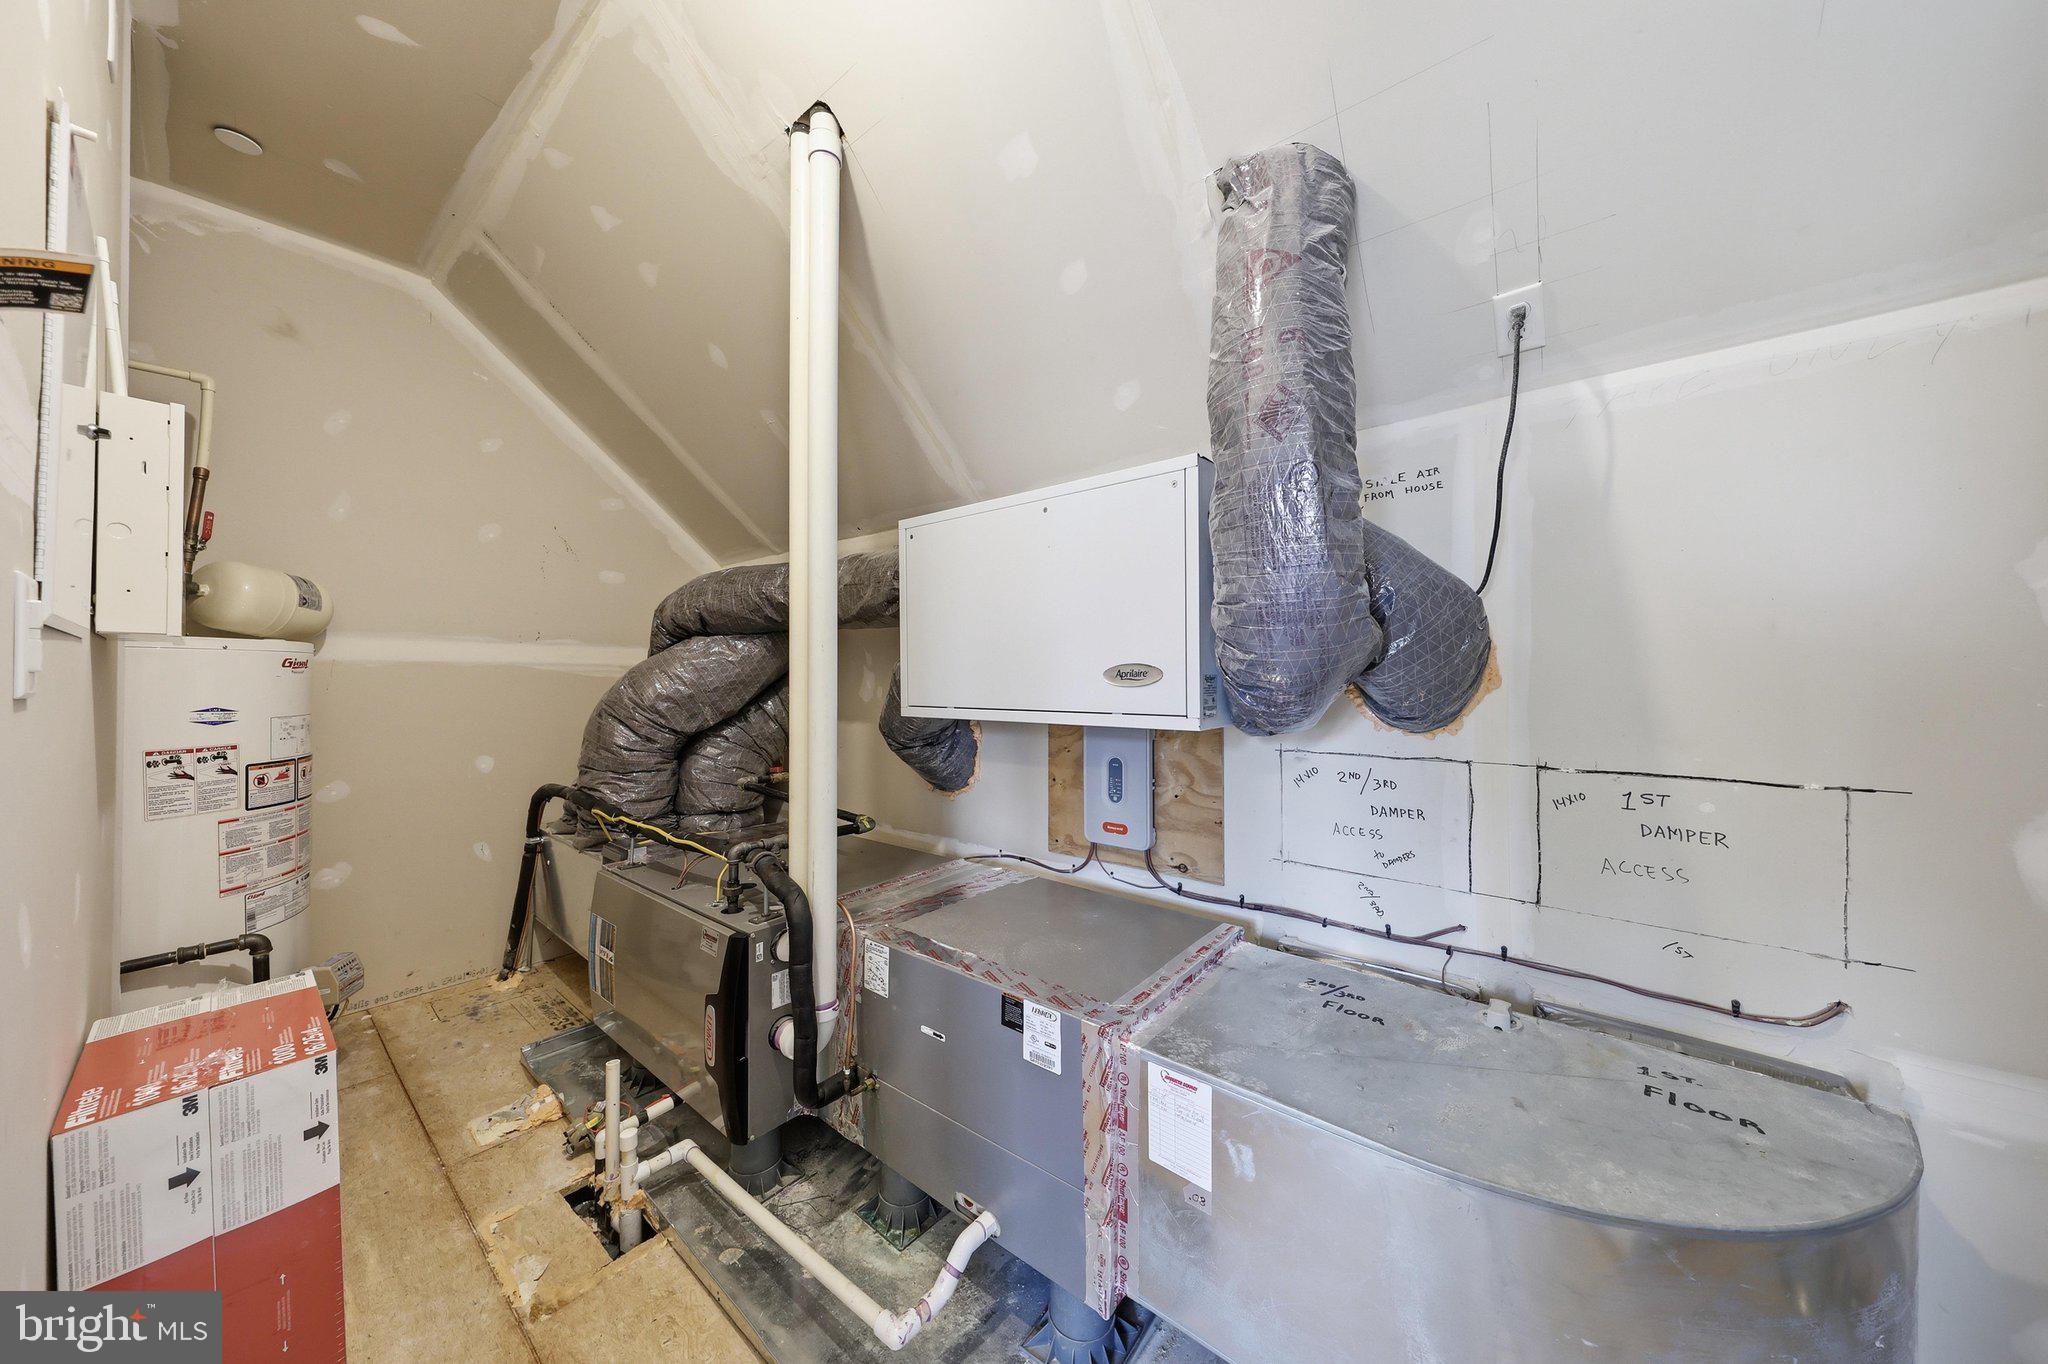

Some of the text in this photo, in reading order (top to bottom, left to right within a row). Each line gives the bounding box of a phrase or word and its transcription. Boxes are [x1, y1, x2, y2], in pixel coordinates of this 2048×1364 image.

[1417, 467, 1441, 479] AIR
[1364, 480, 1444, 503] FROM HOUSE
[1115, 668, 1149, 681] Aprilaire
[1621, 791, 1671, 811] 1ST
[1370, 805, 1426, 821] DAMPER
[1332, 822, 1384, 840] ACCESS
[1641, 823, 1730, 849] DAMPER
[1600, 857, 1691, 884] ACCESS
[315, 1055, 328, 1076] 3M
[182, 1094, 199, 1117] 3M
